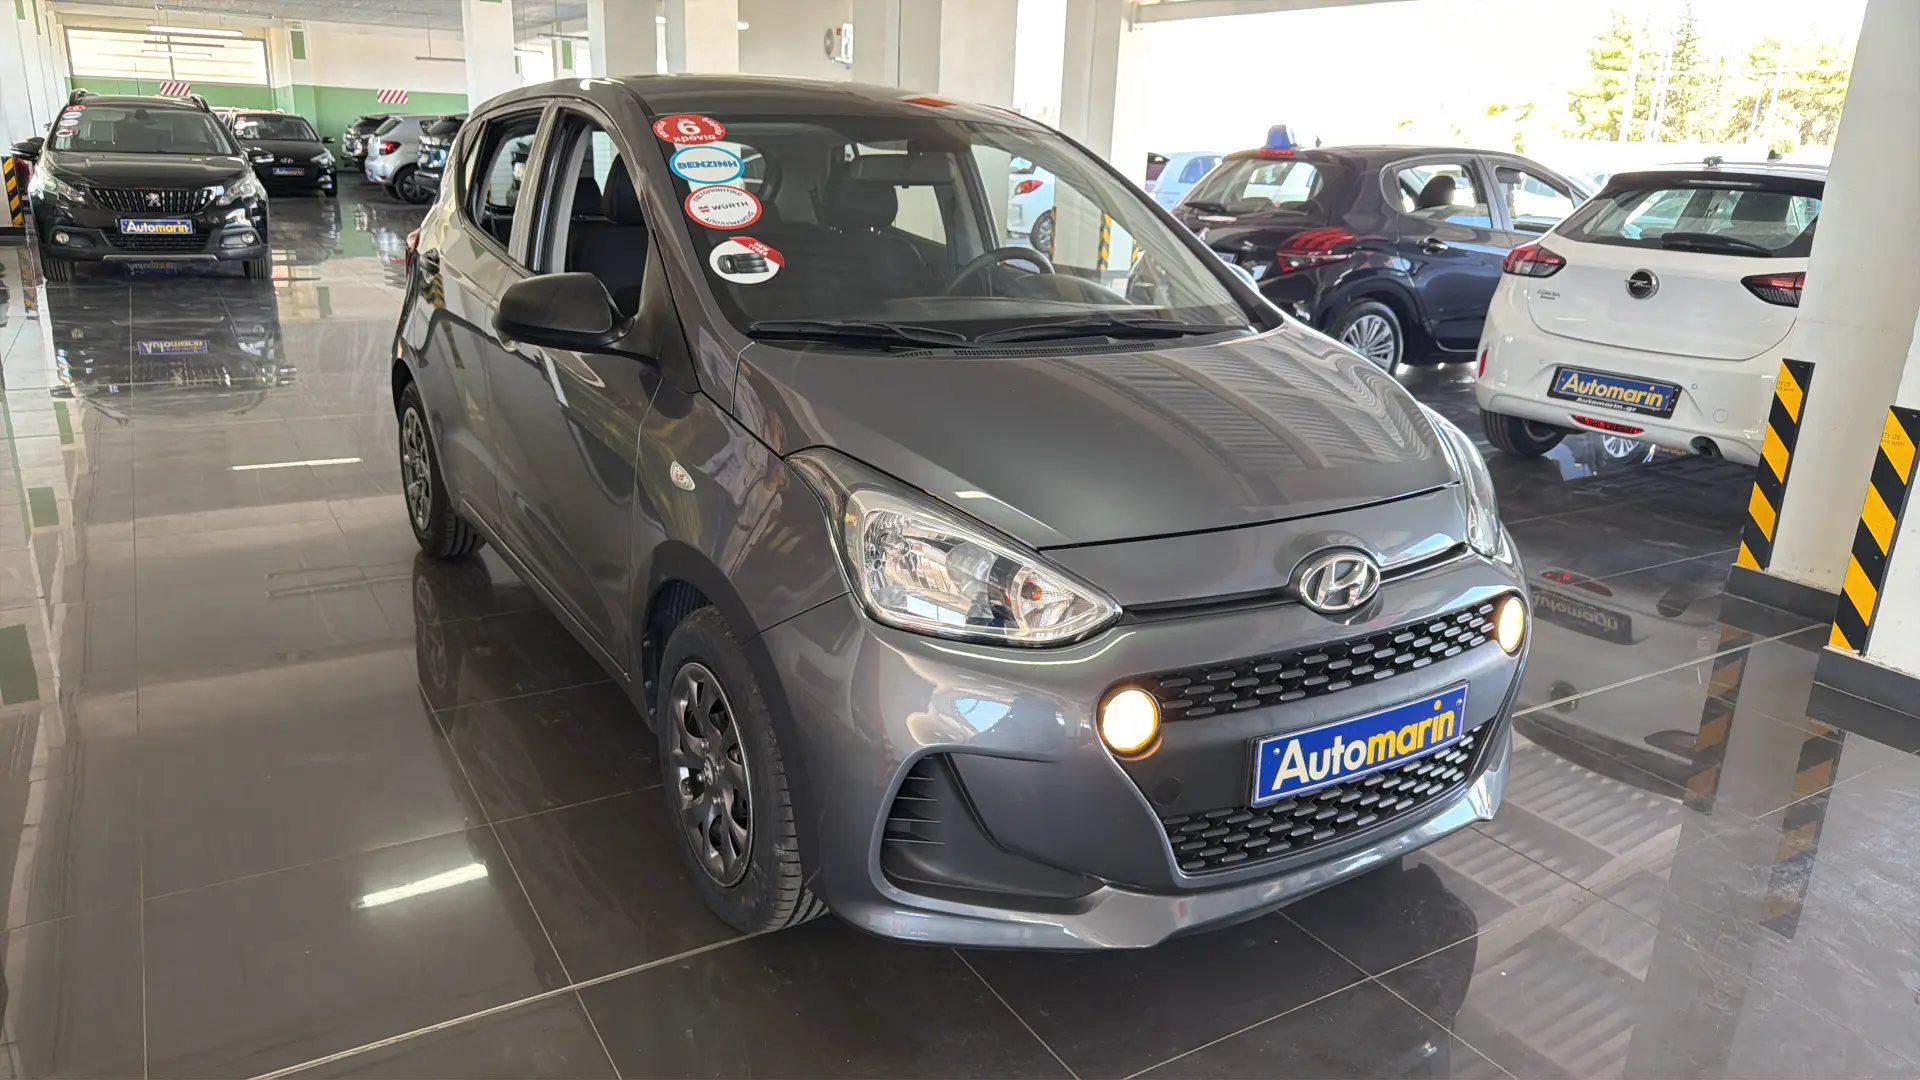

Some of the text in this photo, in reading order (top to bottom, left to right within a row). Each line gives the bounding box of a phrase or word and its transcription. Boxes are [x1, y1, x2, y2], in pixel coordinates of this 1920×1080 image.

[676, 120, 701, 135] 6
[673, 134, 716, 143] χρόνια
[127, 220, 189, 232] Automarin
[1561, 373, 1663, 407] Automarin
[1576, 397, 1637, 412] Automarin.gr
[1271, 699, 1455, 791] Automarin
